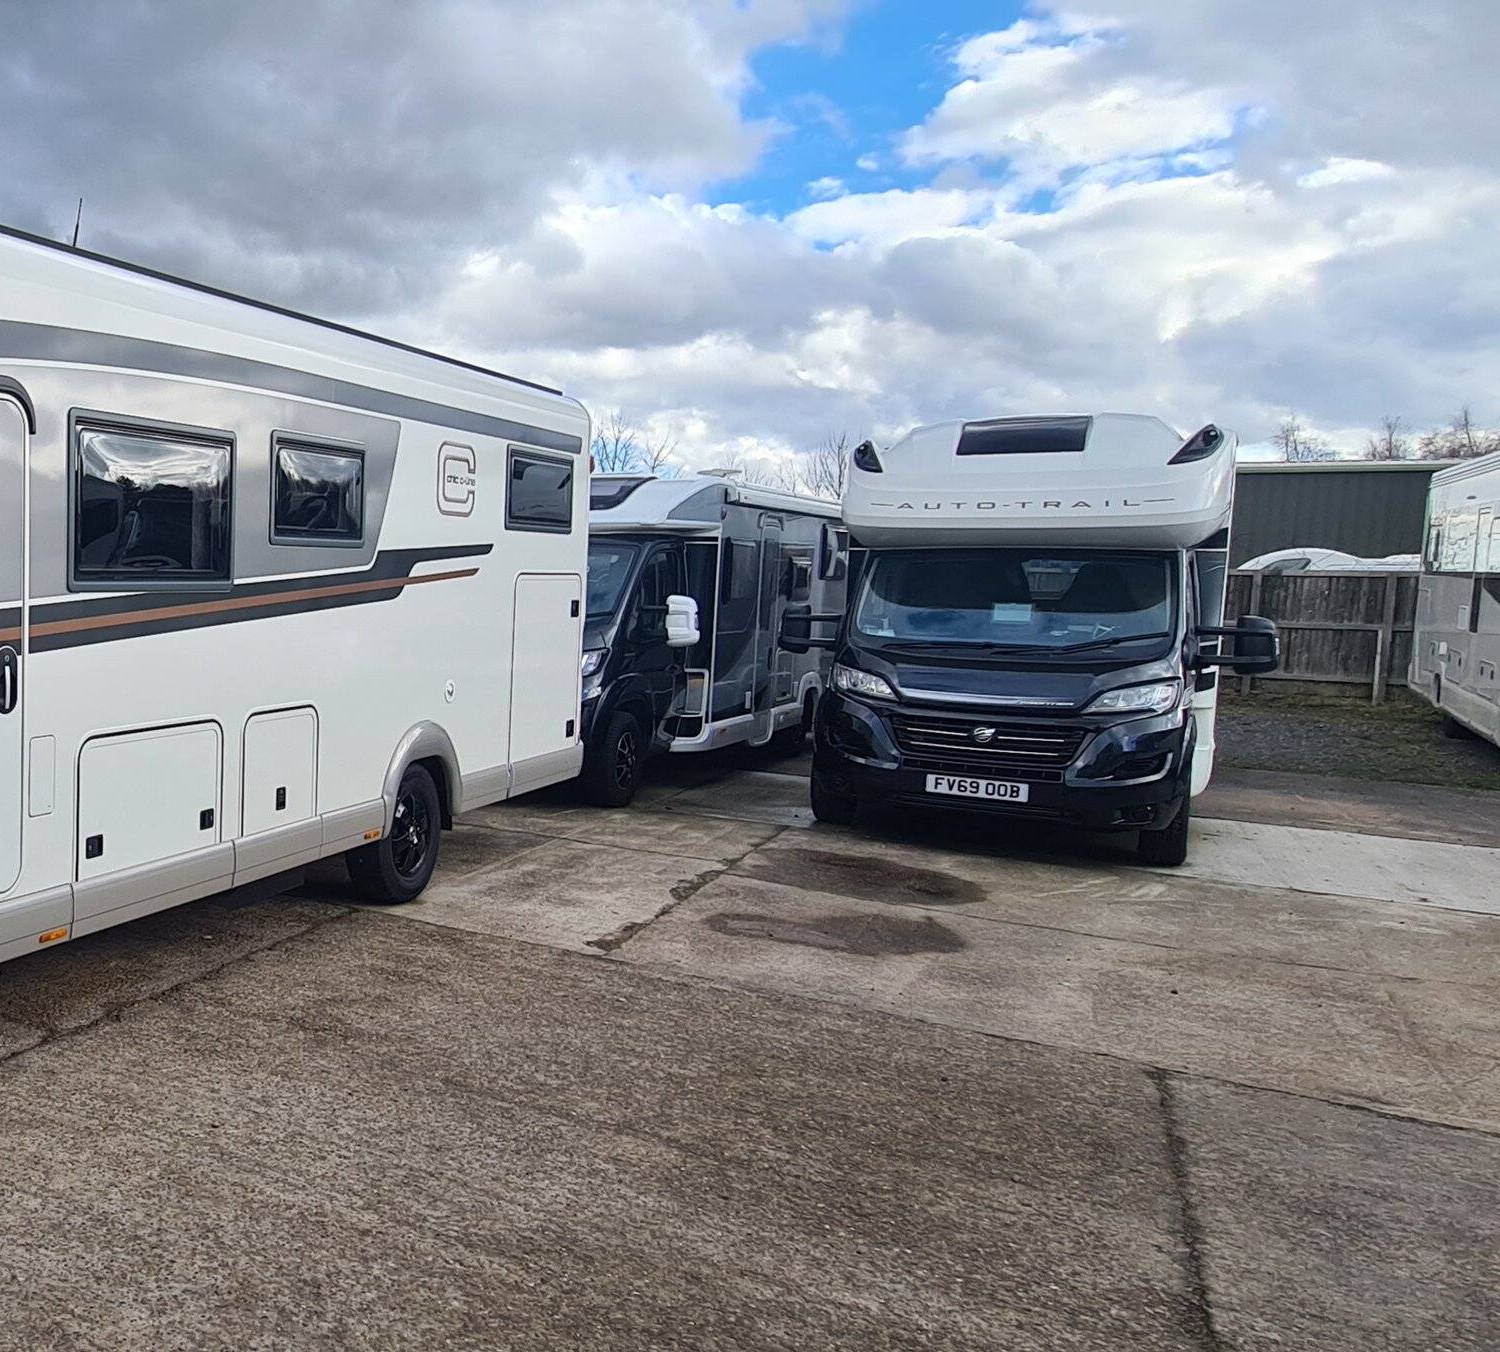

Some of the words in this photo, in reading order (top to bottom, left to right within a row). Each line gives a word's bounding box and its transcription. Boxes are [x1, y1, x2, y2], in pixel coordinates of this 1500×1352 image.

[897, 499, 1141, 510] AUTO-TRAIL
[934, 776, 980, 794] FV69
[985, 782, 1020, 798] OOB
